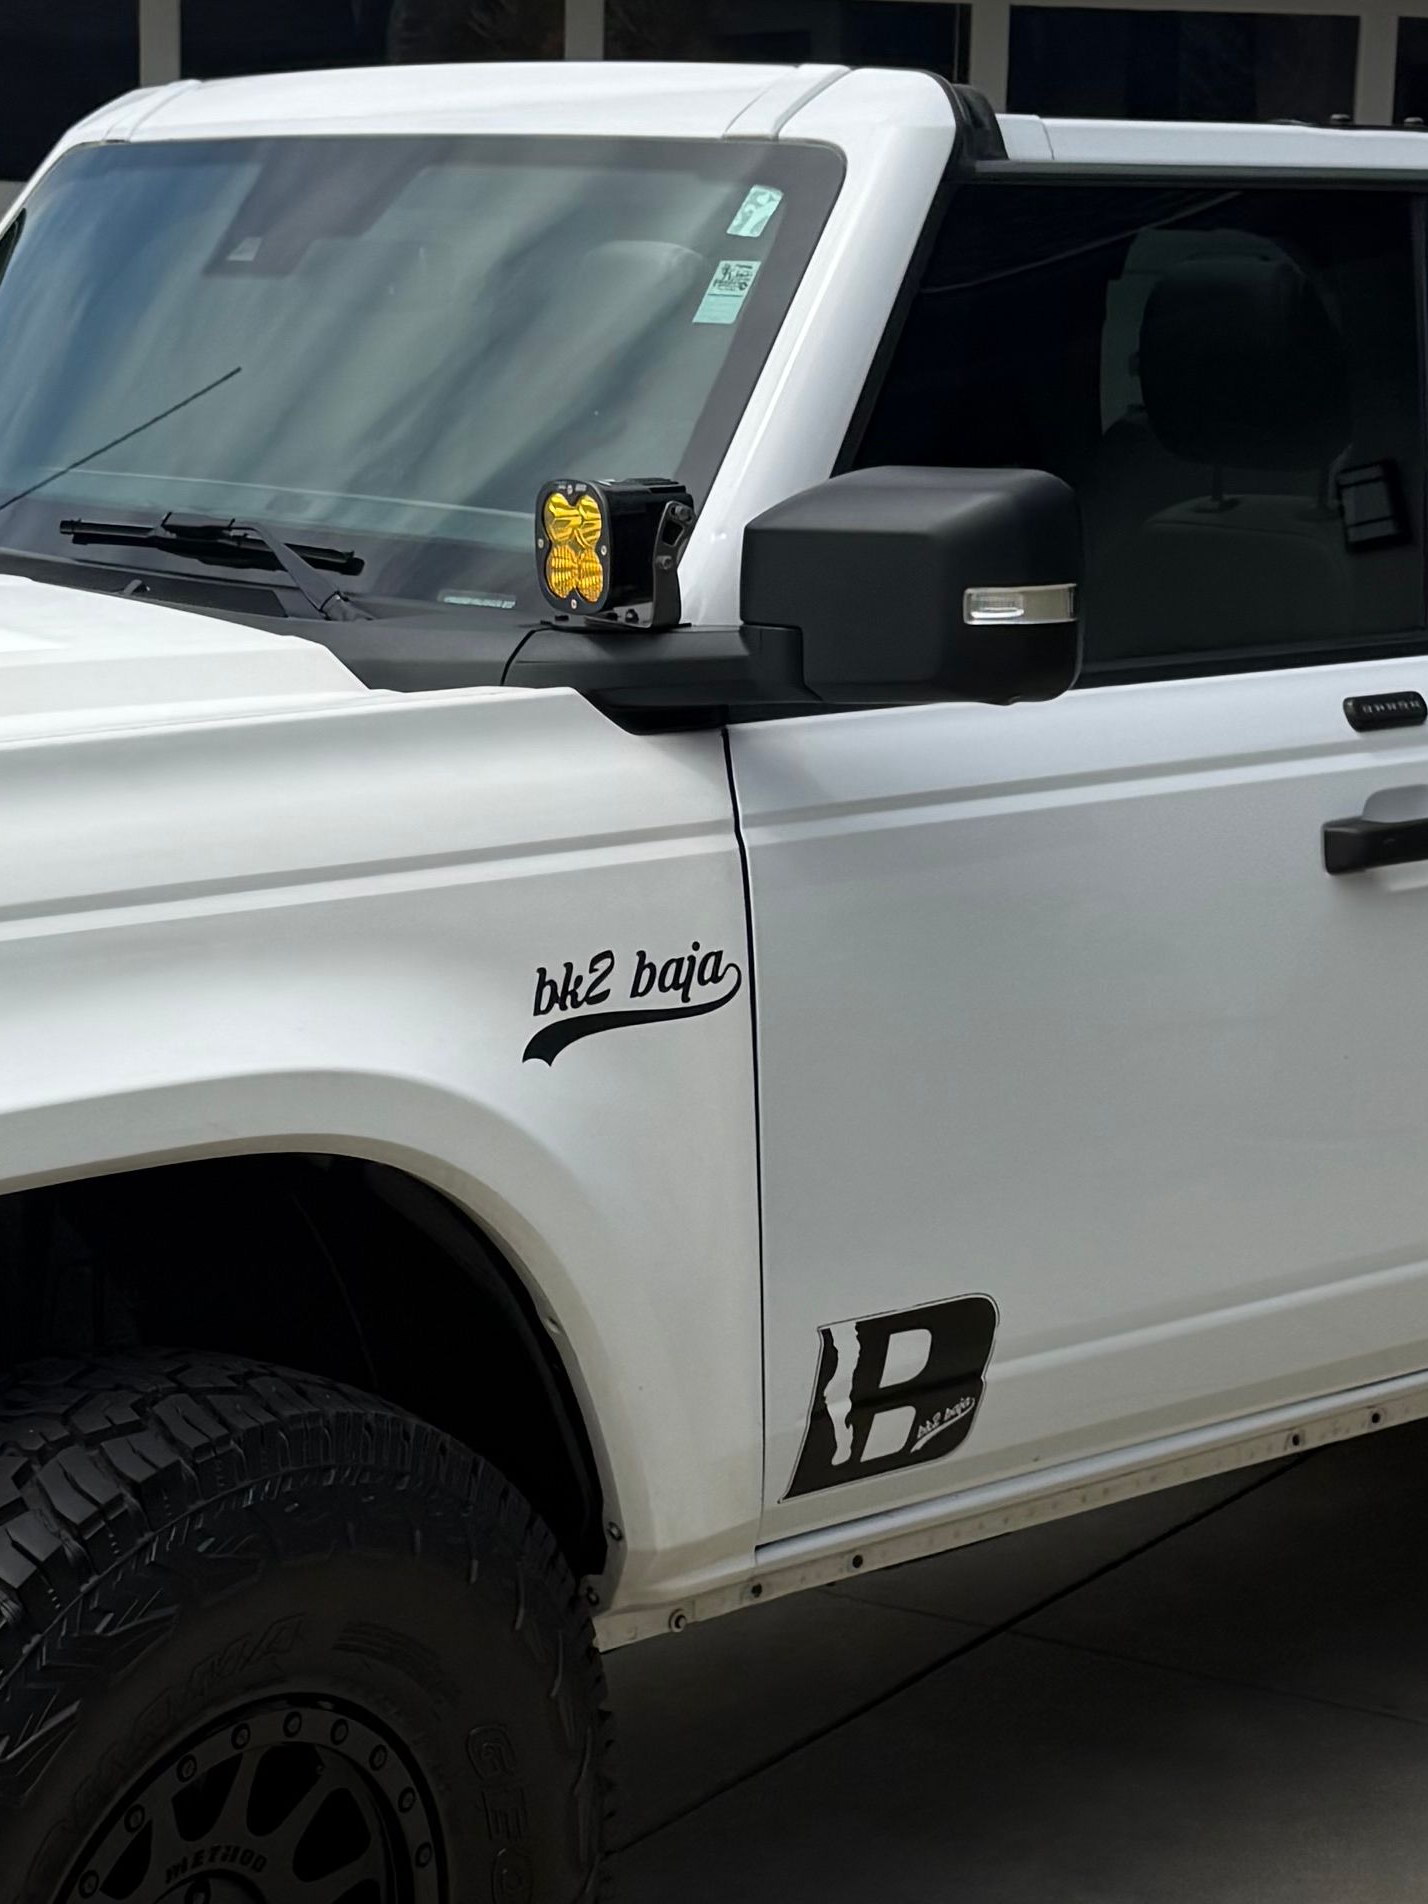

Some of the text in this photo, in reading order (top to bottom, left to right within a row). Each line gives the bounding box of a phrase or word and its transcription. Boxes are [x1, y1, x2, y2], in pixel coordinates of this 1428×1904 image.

[533, 940, 724, 1017] bk2 baja
[166, 1844, 267, 1884] METHOD
